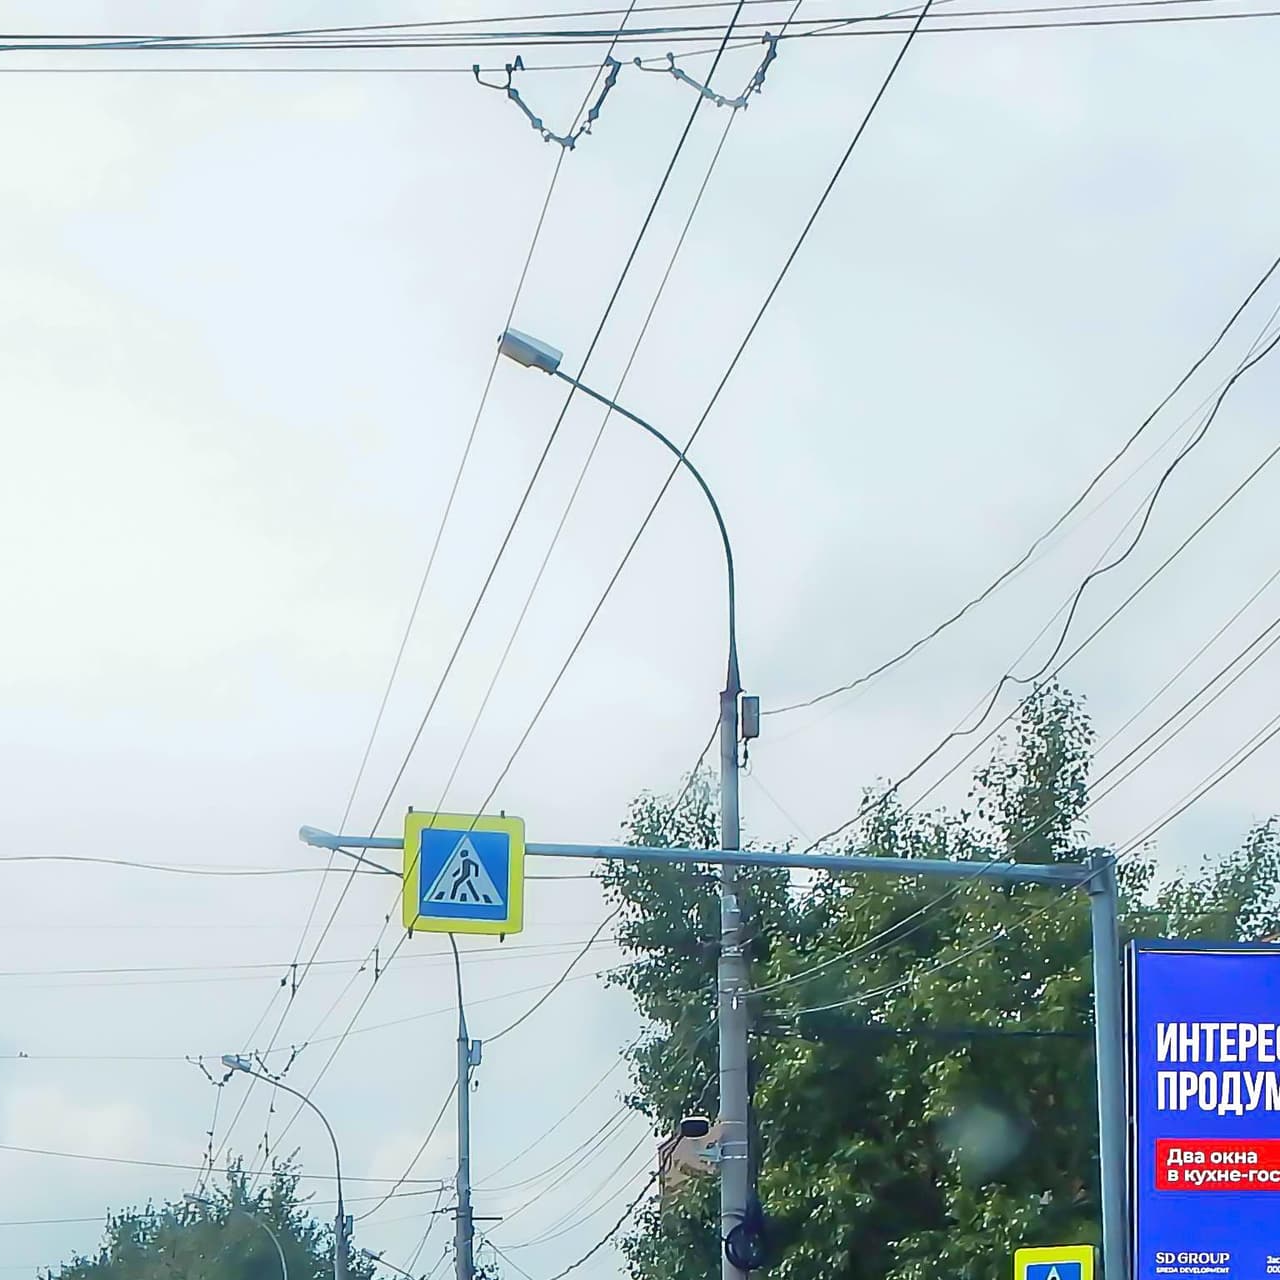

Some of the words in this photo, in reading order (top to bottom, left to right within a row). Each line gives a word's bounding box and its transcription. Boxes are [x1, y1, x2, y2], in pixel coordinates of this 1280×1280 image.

[1167, 1149, 1205, 1166] Два
[1210, 1151, 1258, 1164] окна
[1167, 1170, 1179, 1182] в
[1156, 1252, 1175, 1264] SD
[1178, 1252, 1230, 1264] GROUP
